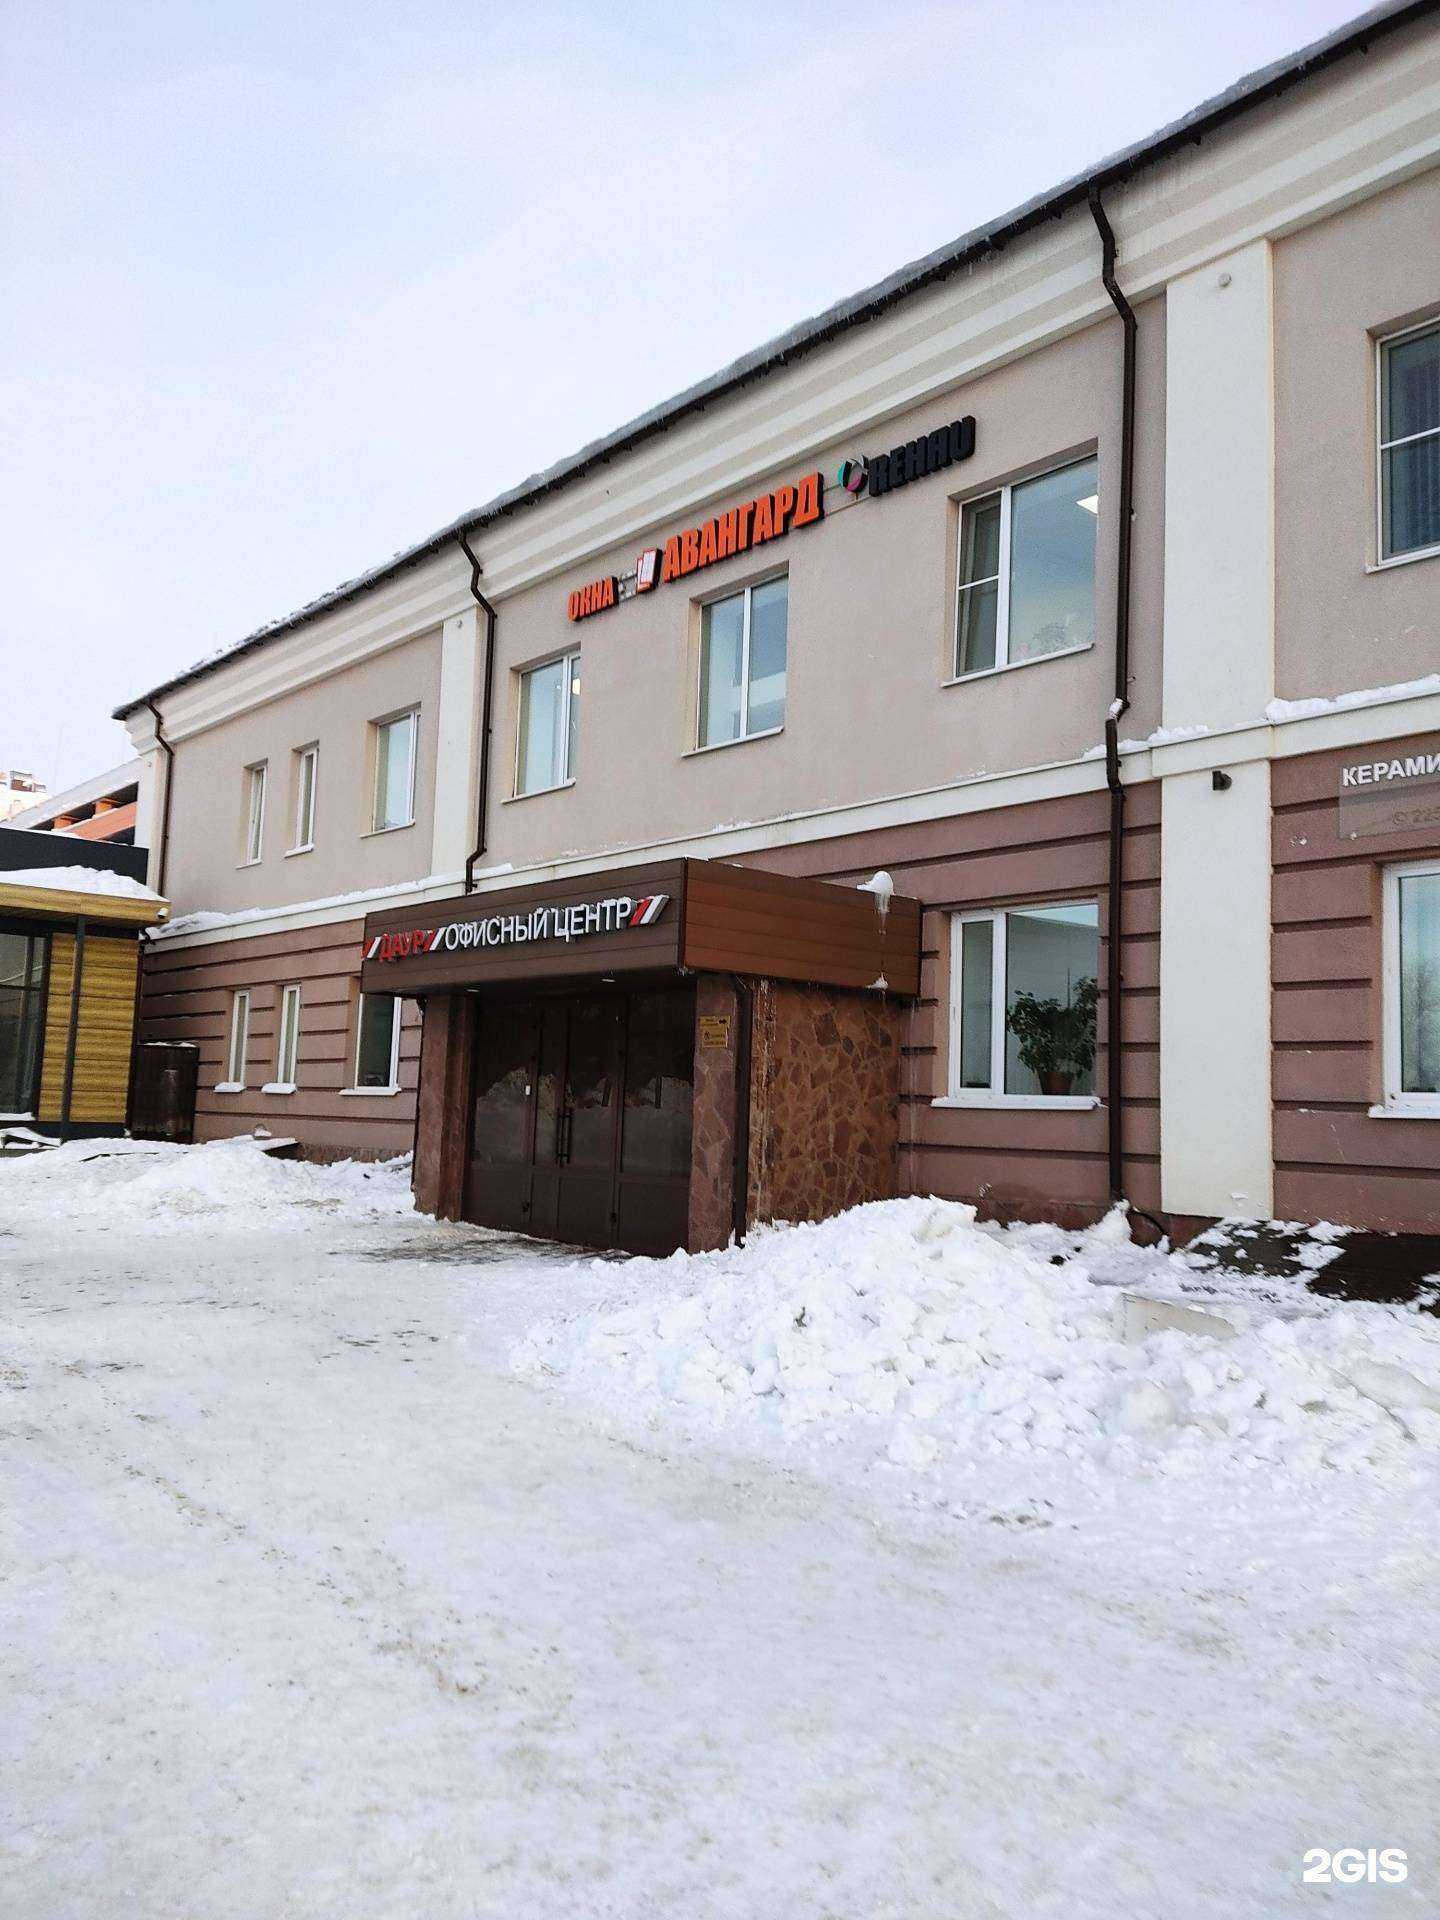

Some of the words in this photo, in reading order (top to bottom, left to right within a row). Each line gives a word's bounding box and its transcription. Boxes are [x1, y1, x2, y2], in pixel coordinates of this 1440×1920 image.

[868, 415, 976, 497] REHAU
[567, 576, 617, 621] ОКНА
[663, 473, 823, 583] АВАНГАРД
[445, 907, 548, 950] ОФИСНЫЙ
[553, 897, 632, 943] ЦЕНТР
